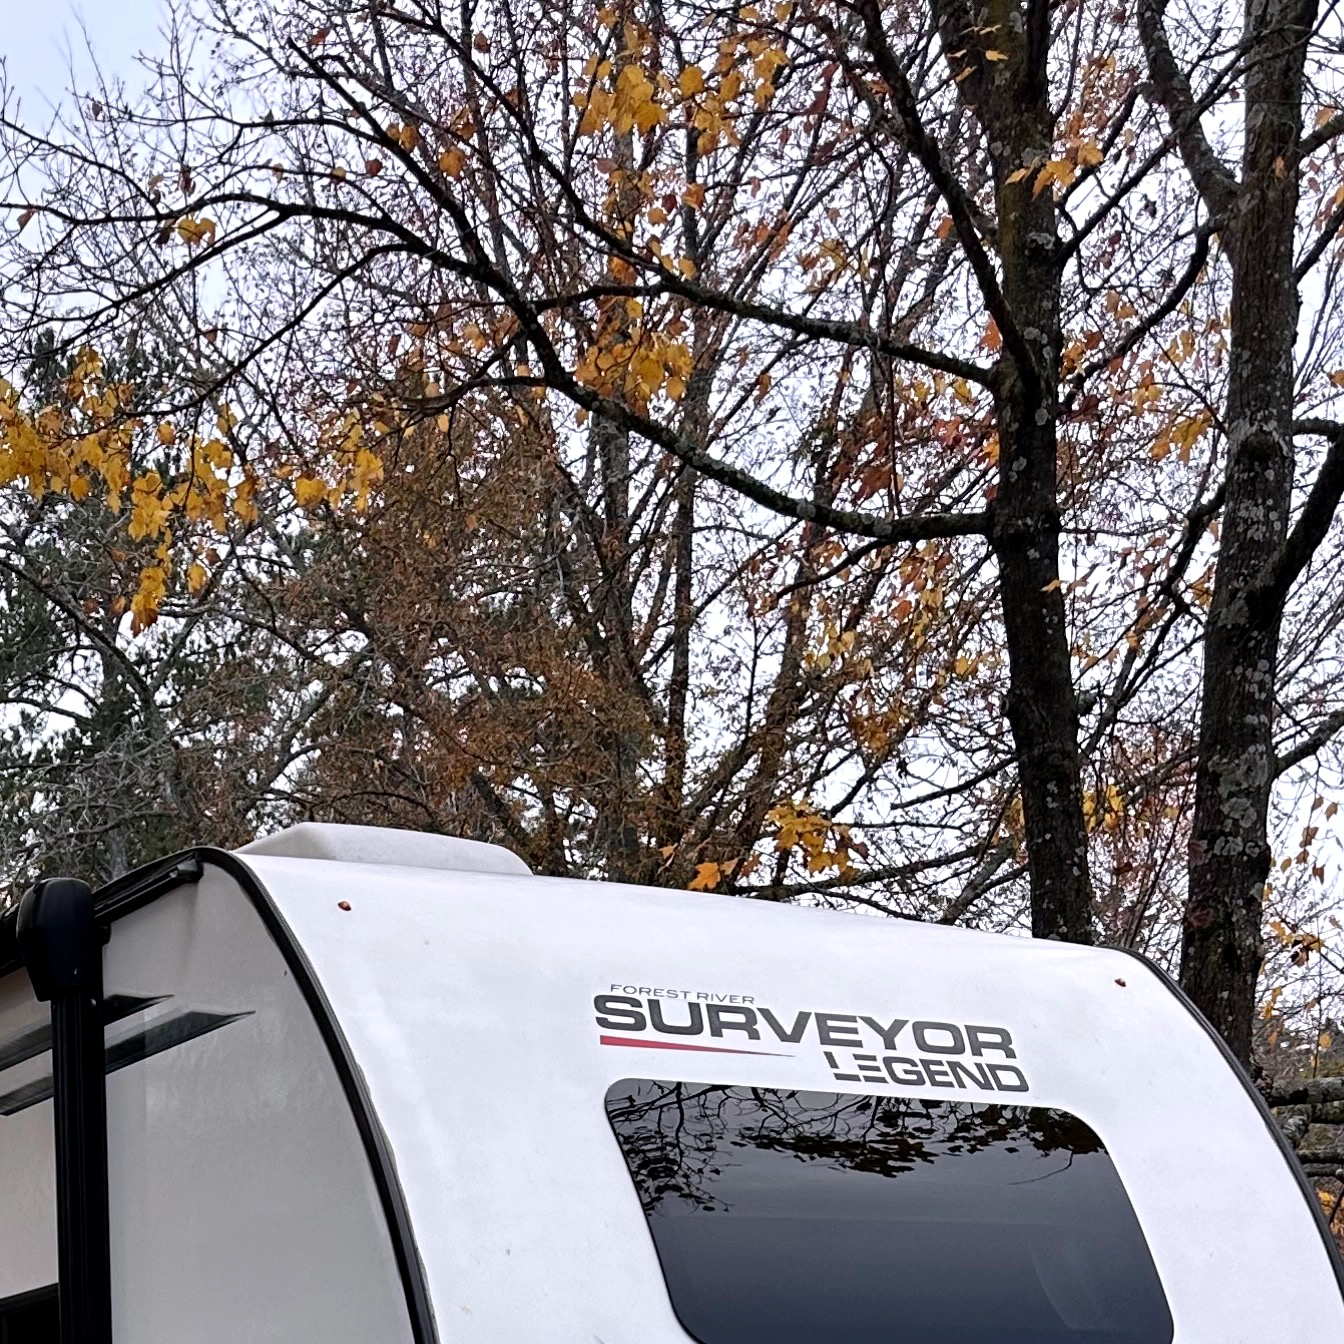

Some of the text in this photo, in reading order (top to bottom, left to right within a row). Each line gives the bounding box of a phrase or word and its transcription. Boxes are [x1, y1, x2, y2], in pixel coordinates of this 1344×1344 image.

[610, 984, 755, 1005] FOREST RIVER
[593, 994, 1017, 1060] SURVEYOR
[823, 1050, 1030, 1093] LEGEND
